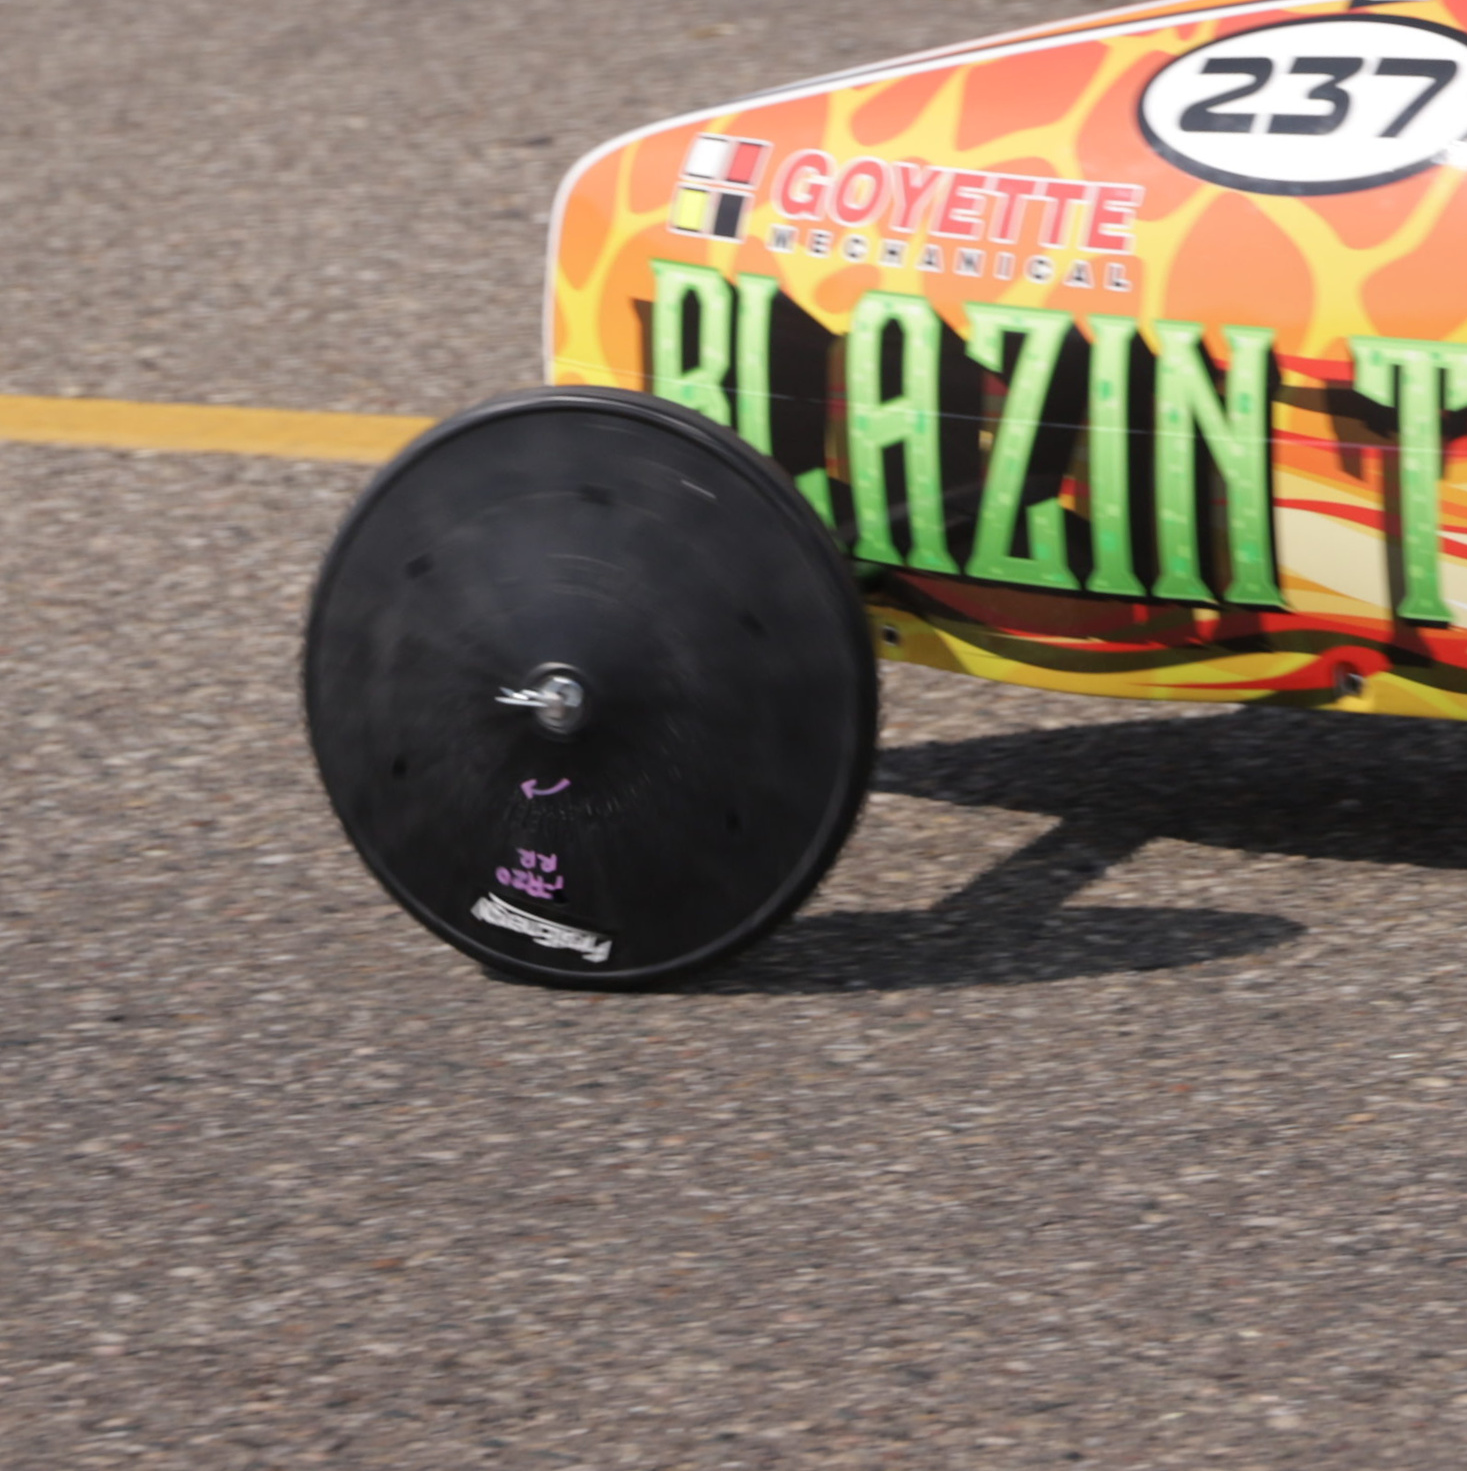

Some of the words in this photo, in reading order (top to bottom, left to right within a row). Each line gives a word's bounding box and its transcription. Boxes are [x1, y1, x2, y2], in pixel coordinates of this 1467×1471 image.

[1176, 55, 1458, 138] 237
[773, 149, 1145, 254] GOYETTE
[767, 224, 1133, 292] MECHANICAL
[650, 257, 1287, 613] BLAZIN
